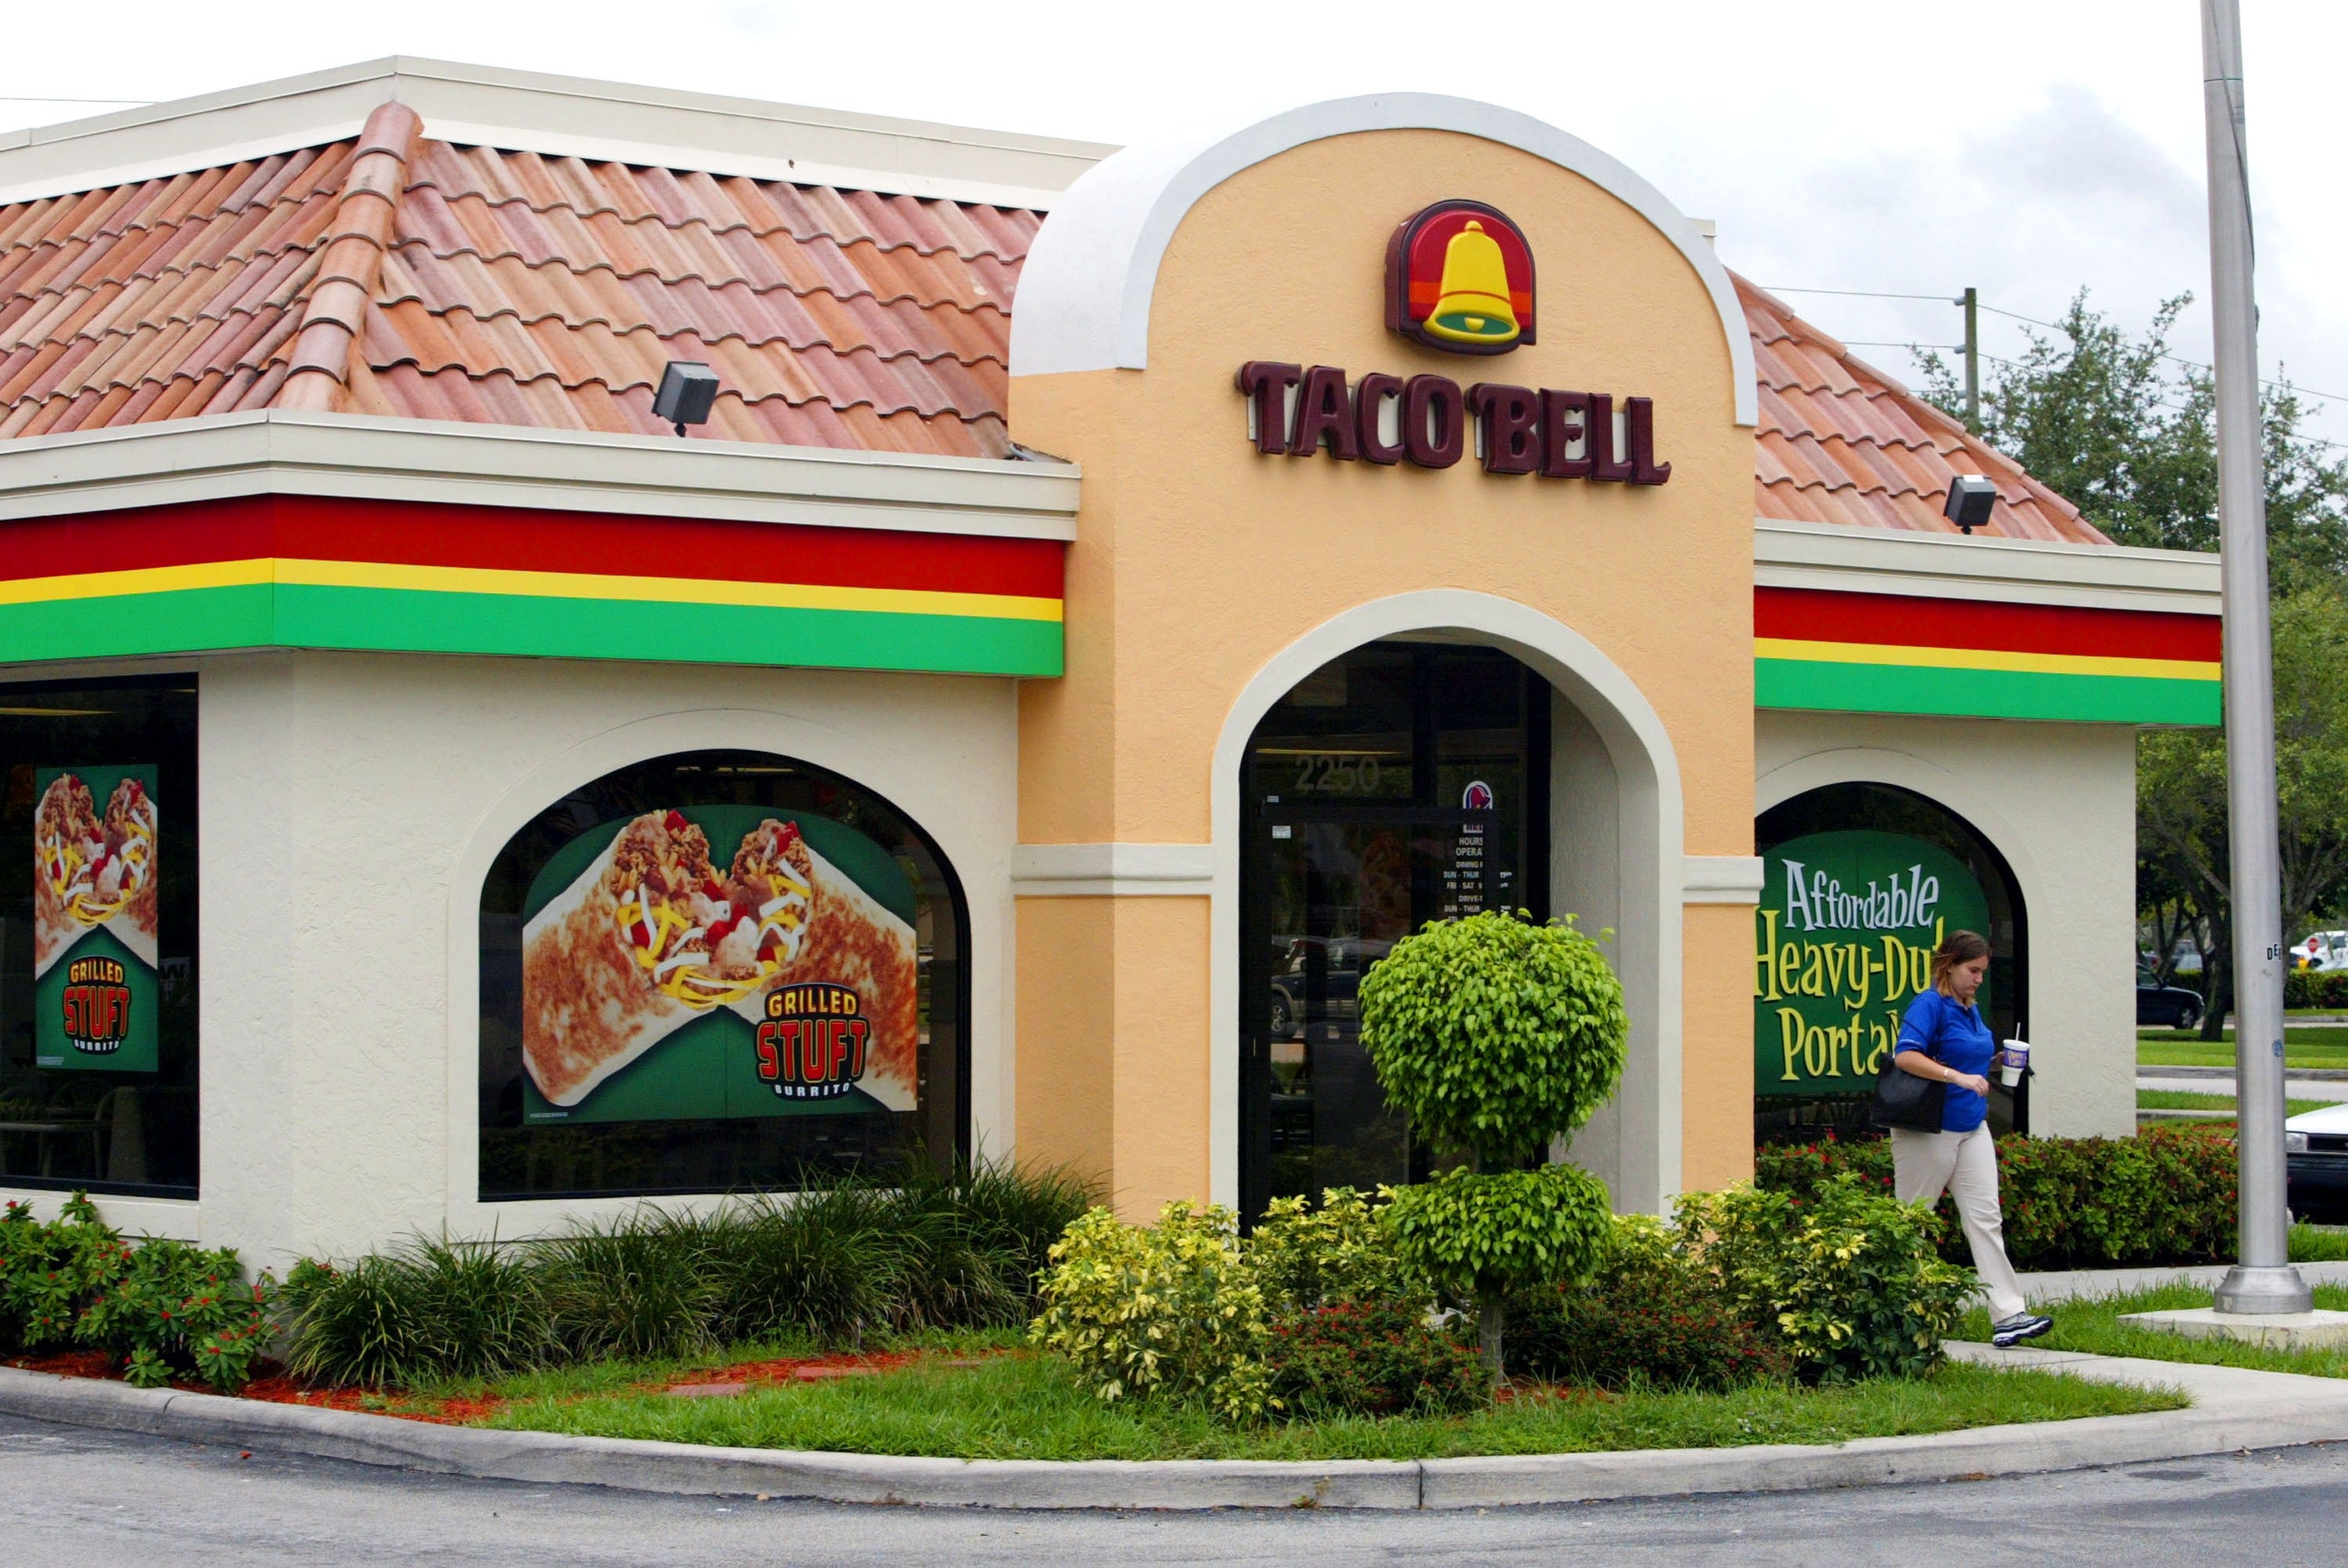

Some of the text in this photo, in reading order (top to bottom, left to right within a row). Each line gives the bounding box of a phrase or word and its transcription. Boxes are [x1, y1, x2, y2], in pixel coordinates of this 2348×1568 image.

[1237, 361, 1672, 486] TACO BELL
[1295, 754, 1380, 793] 2250
[1456, 847, 1483, 856] OPERA
[1459, 836, 1483, 846] HOURS
[1781, 858, 1939, 931] Affordable
[70, 959, 124, 984] GRILLED
[63, 985, 130, 1040] STUFT
[769, 987, 858, 1017] GRILLED
[757, 1020, 867, 1084] STUFT
[774, 1082, 850, 1097] BURRITO
